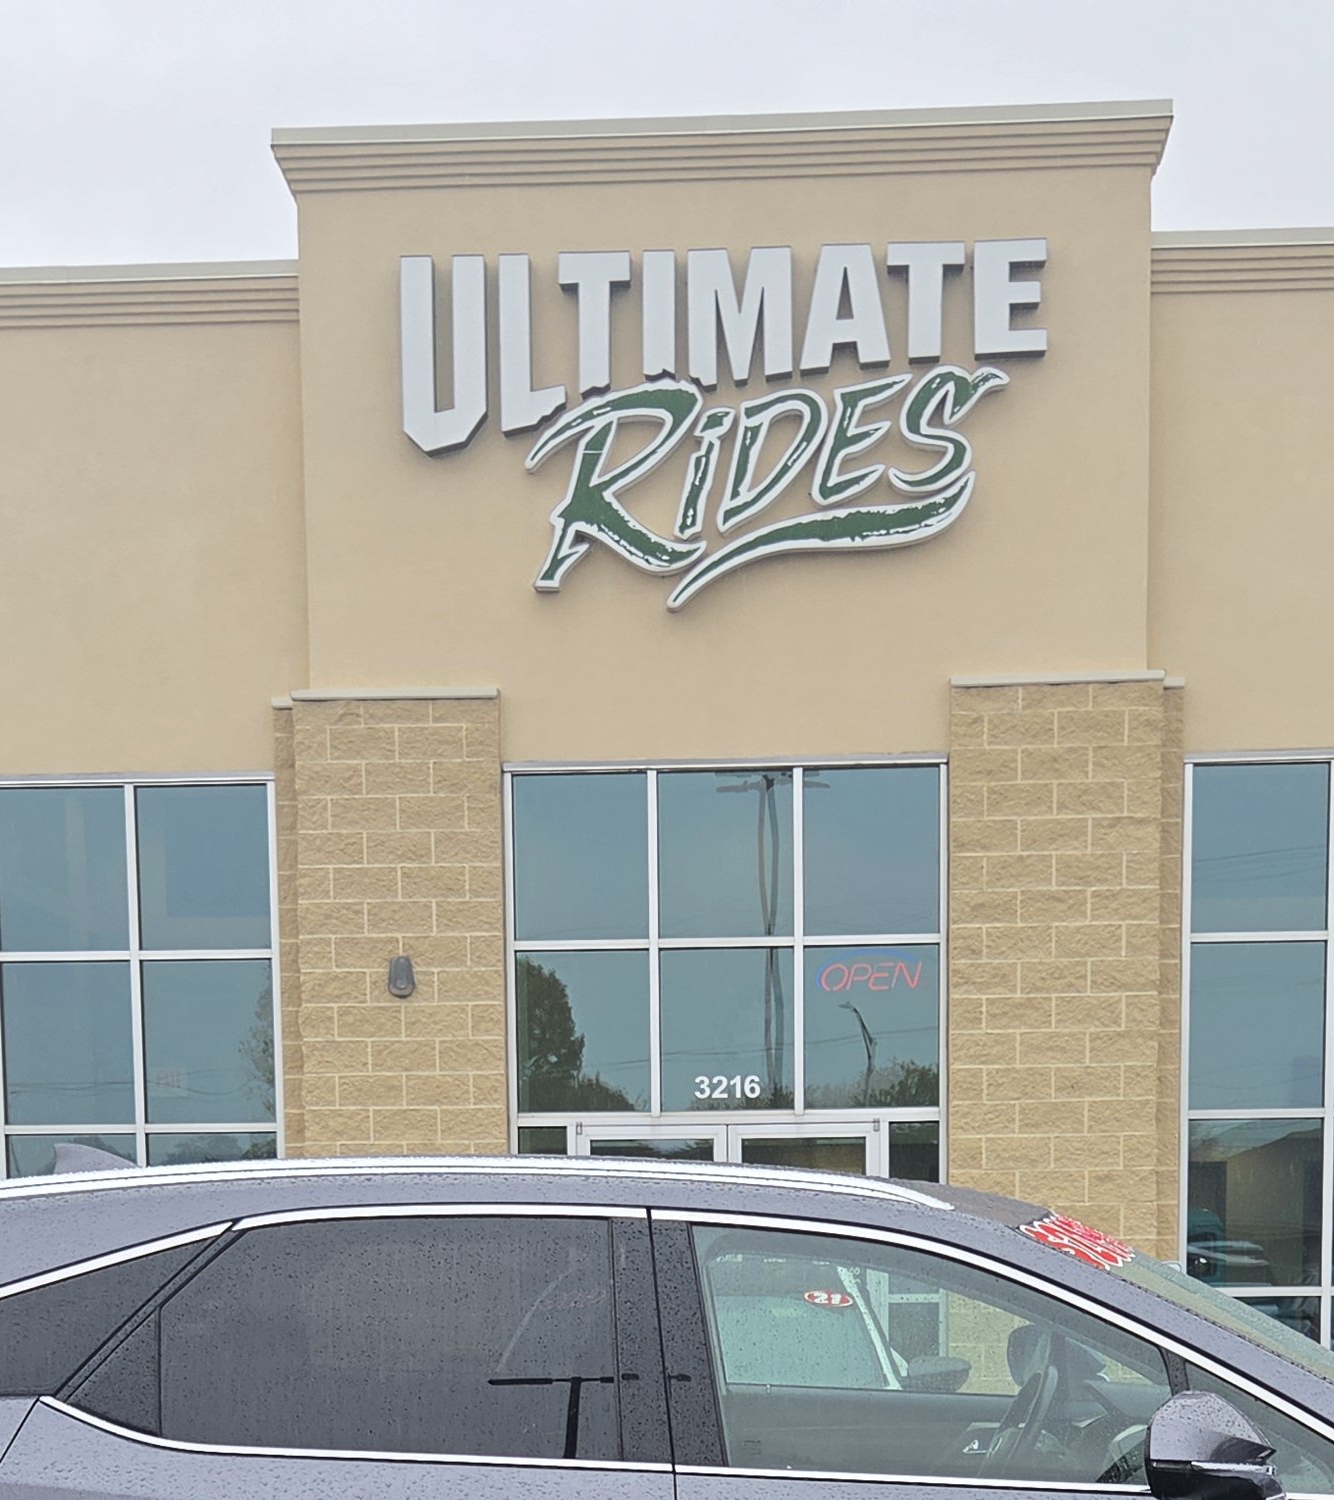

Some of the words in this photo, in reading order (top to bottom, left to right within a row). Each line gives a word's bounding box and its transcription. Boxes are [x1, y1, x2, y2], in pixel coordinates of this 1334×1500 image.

[400, 238, 1048, 457] ULTIMATE
[821, 959, 923, 992] OPEN
[694, 1074, 761, 1099] 3216
